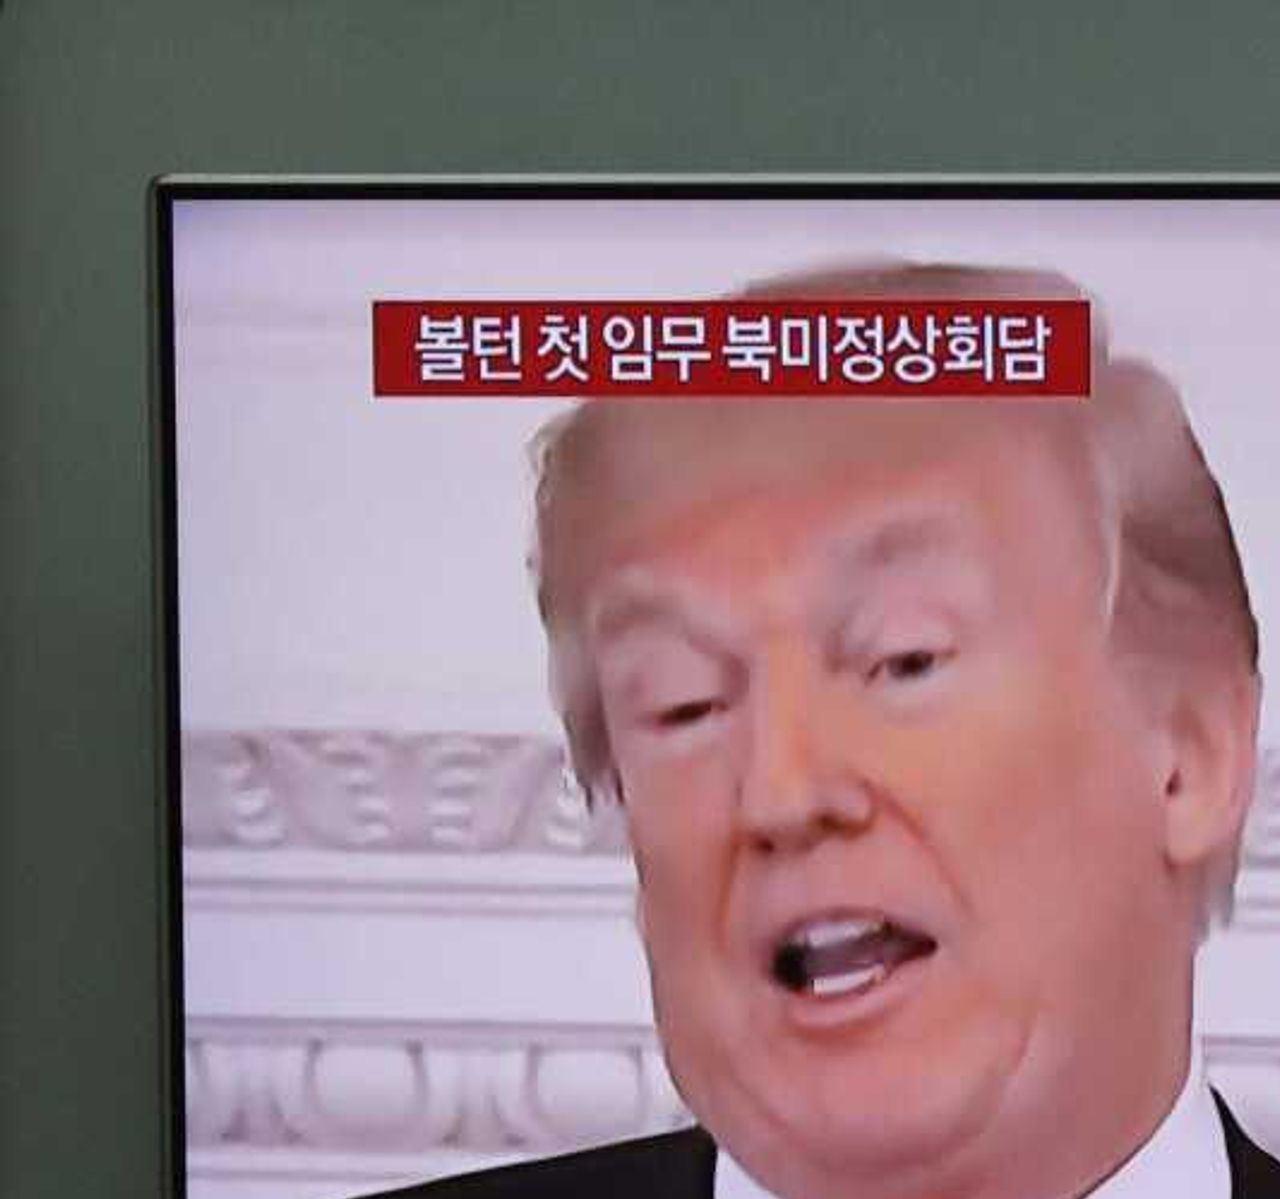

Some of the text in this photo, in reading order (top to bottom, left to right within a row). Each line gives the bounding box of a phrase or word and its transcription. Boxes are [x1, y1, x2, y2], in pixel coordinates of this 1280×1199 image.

[414, 315, 1052, 383] 볼턴 첫 임무 북미정상회담
